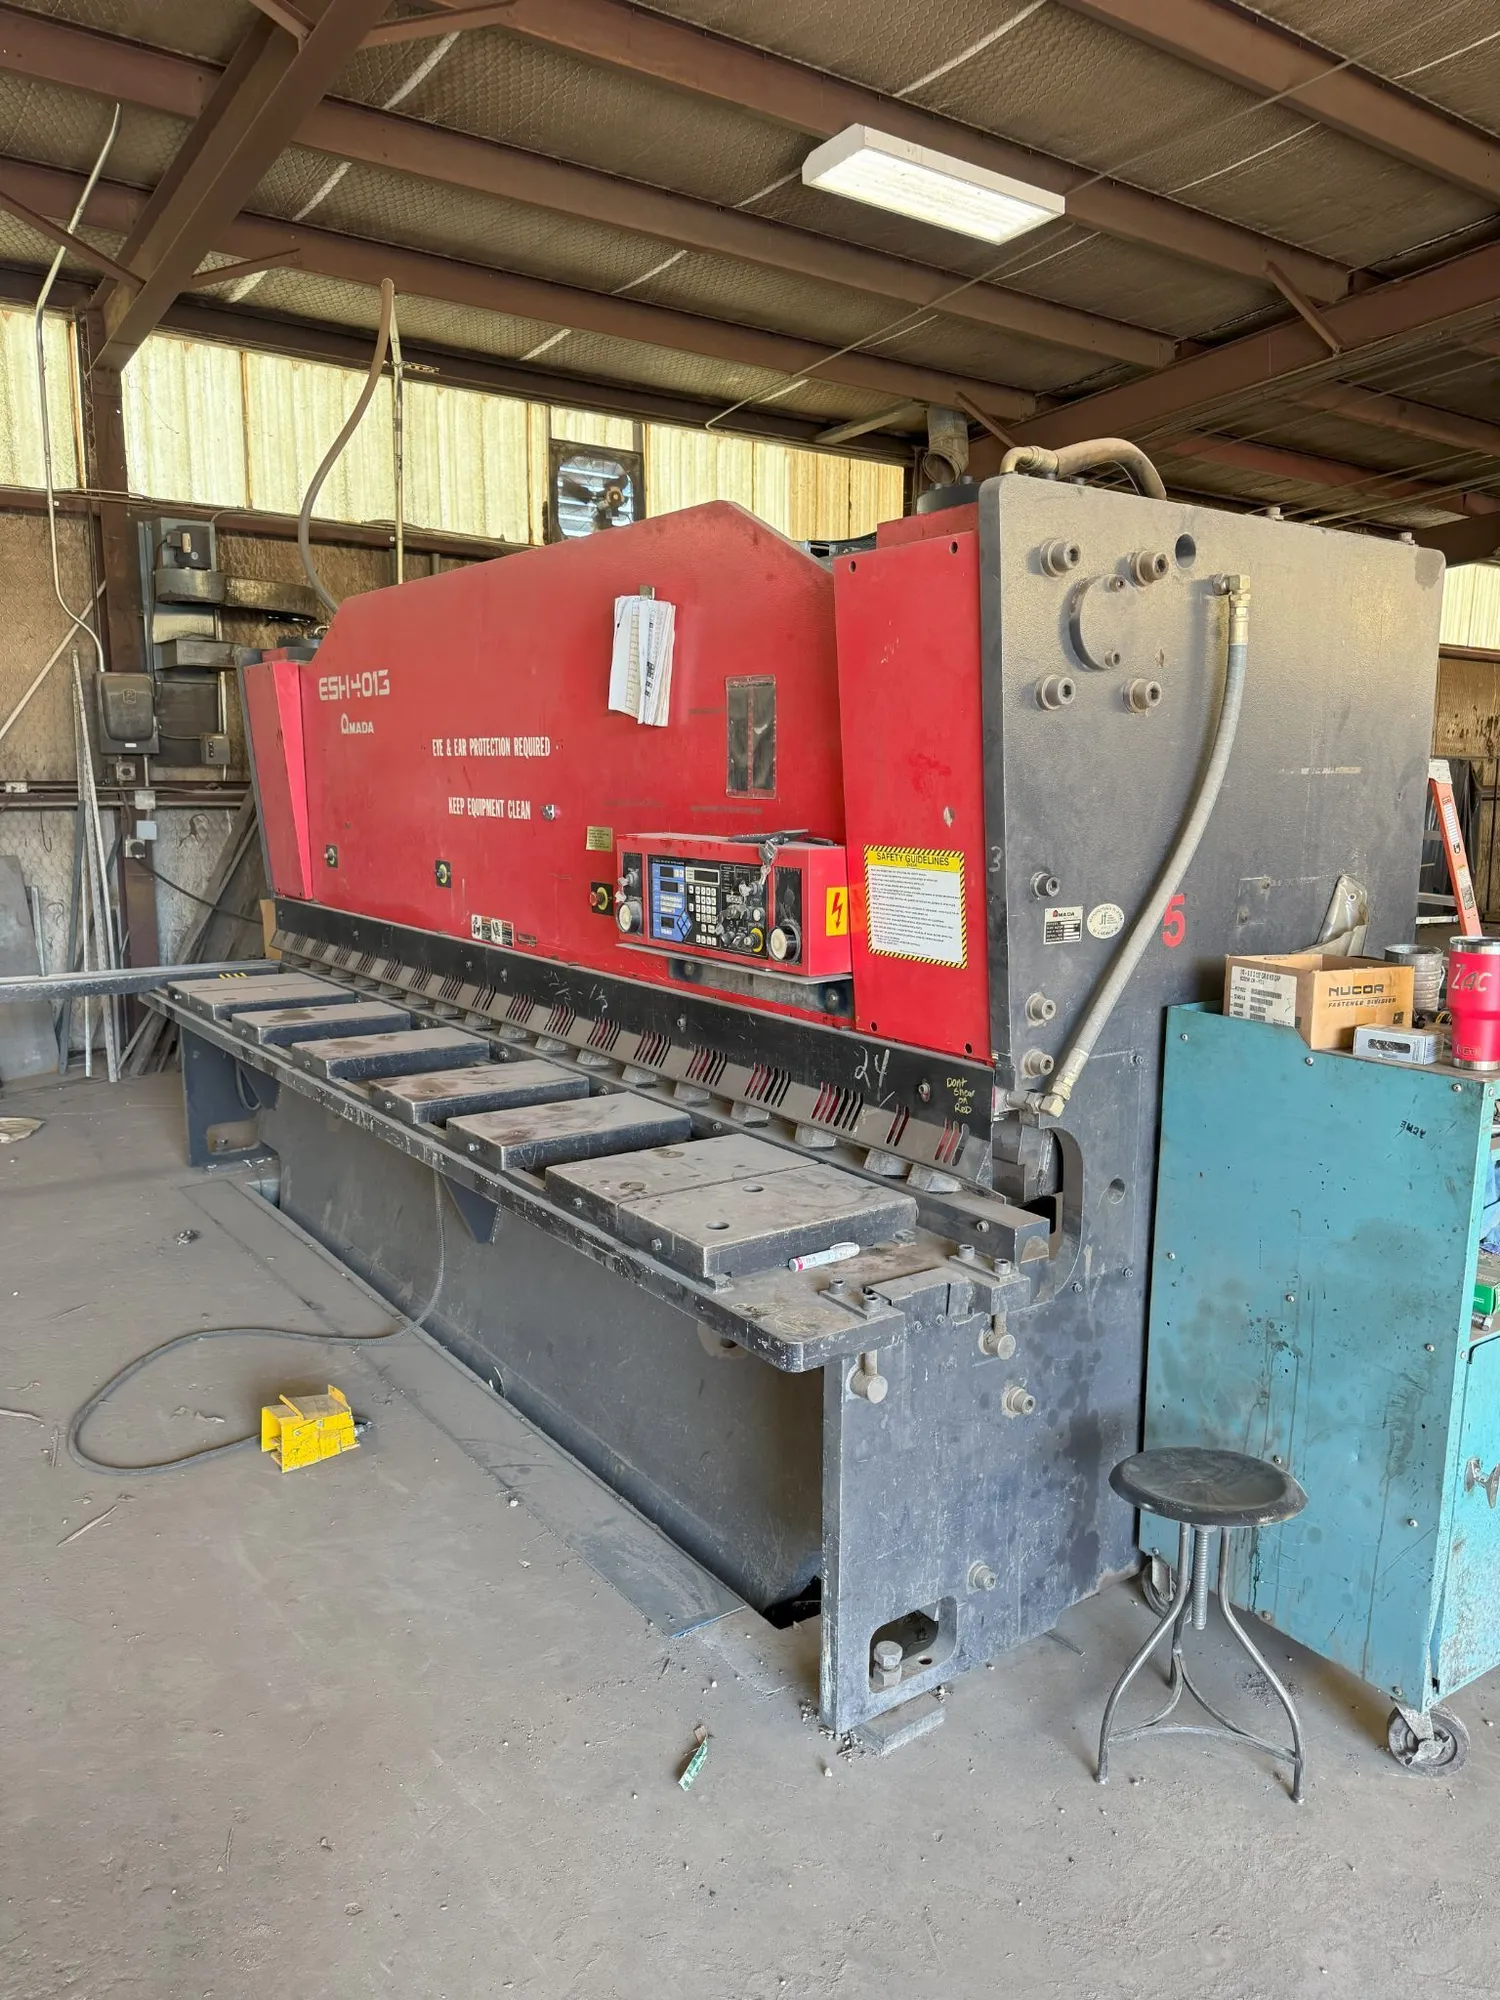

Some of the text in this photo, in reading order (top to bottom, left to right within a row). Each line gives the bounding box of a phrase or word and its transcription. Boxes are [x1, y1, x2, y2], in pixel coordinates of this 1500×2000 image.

[432, 737, 551, 759] EYE & EAR PROTECTION REQUIRED
[448, 797, 531, 820] KEEP EQUIPMENT CLEAN
[876, 852, 950, 866] SAFETY GUIDELINES
[1162, 893, 1187, 949] 5
[1451, 963, 1493, 993] ZAC
[1328, 984, 1385, 997] NUCOR
[1366, 998, 1397, 1006] DIVISION
[854, 1045, 890, 1101] 24
[958, 1097, 968, 1105] on
